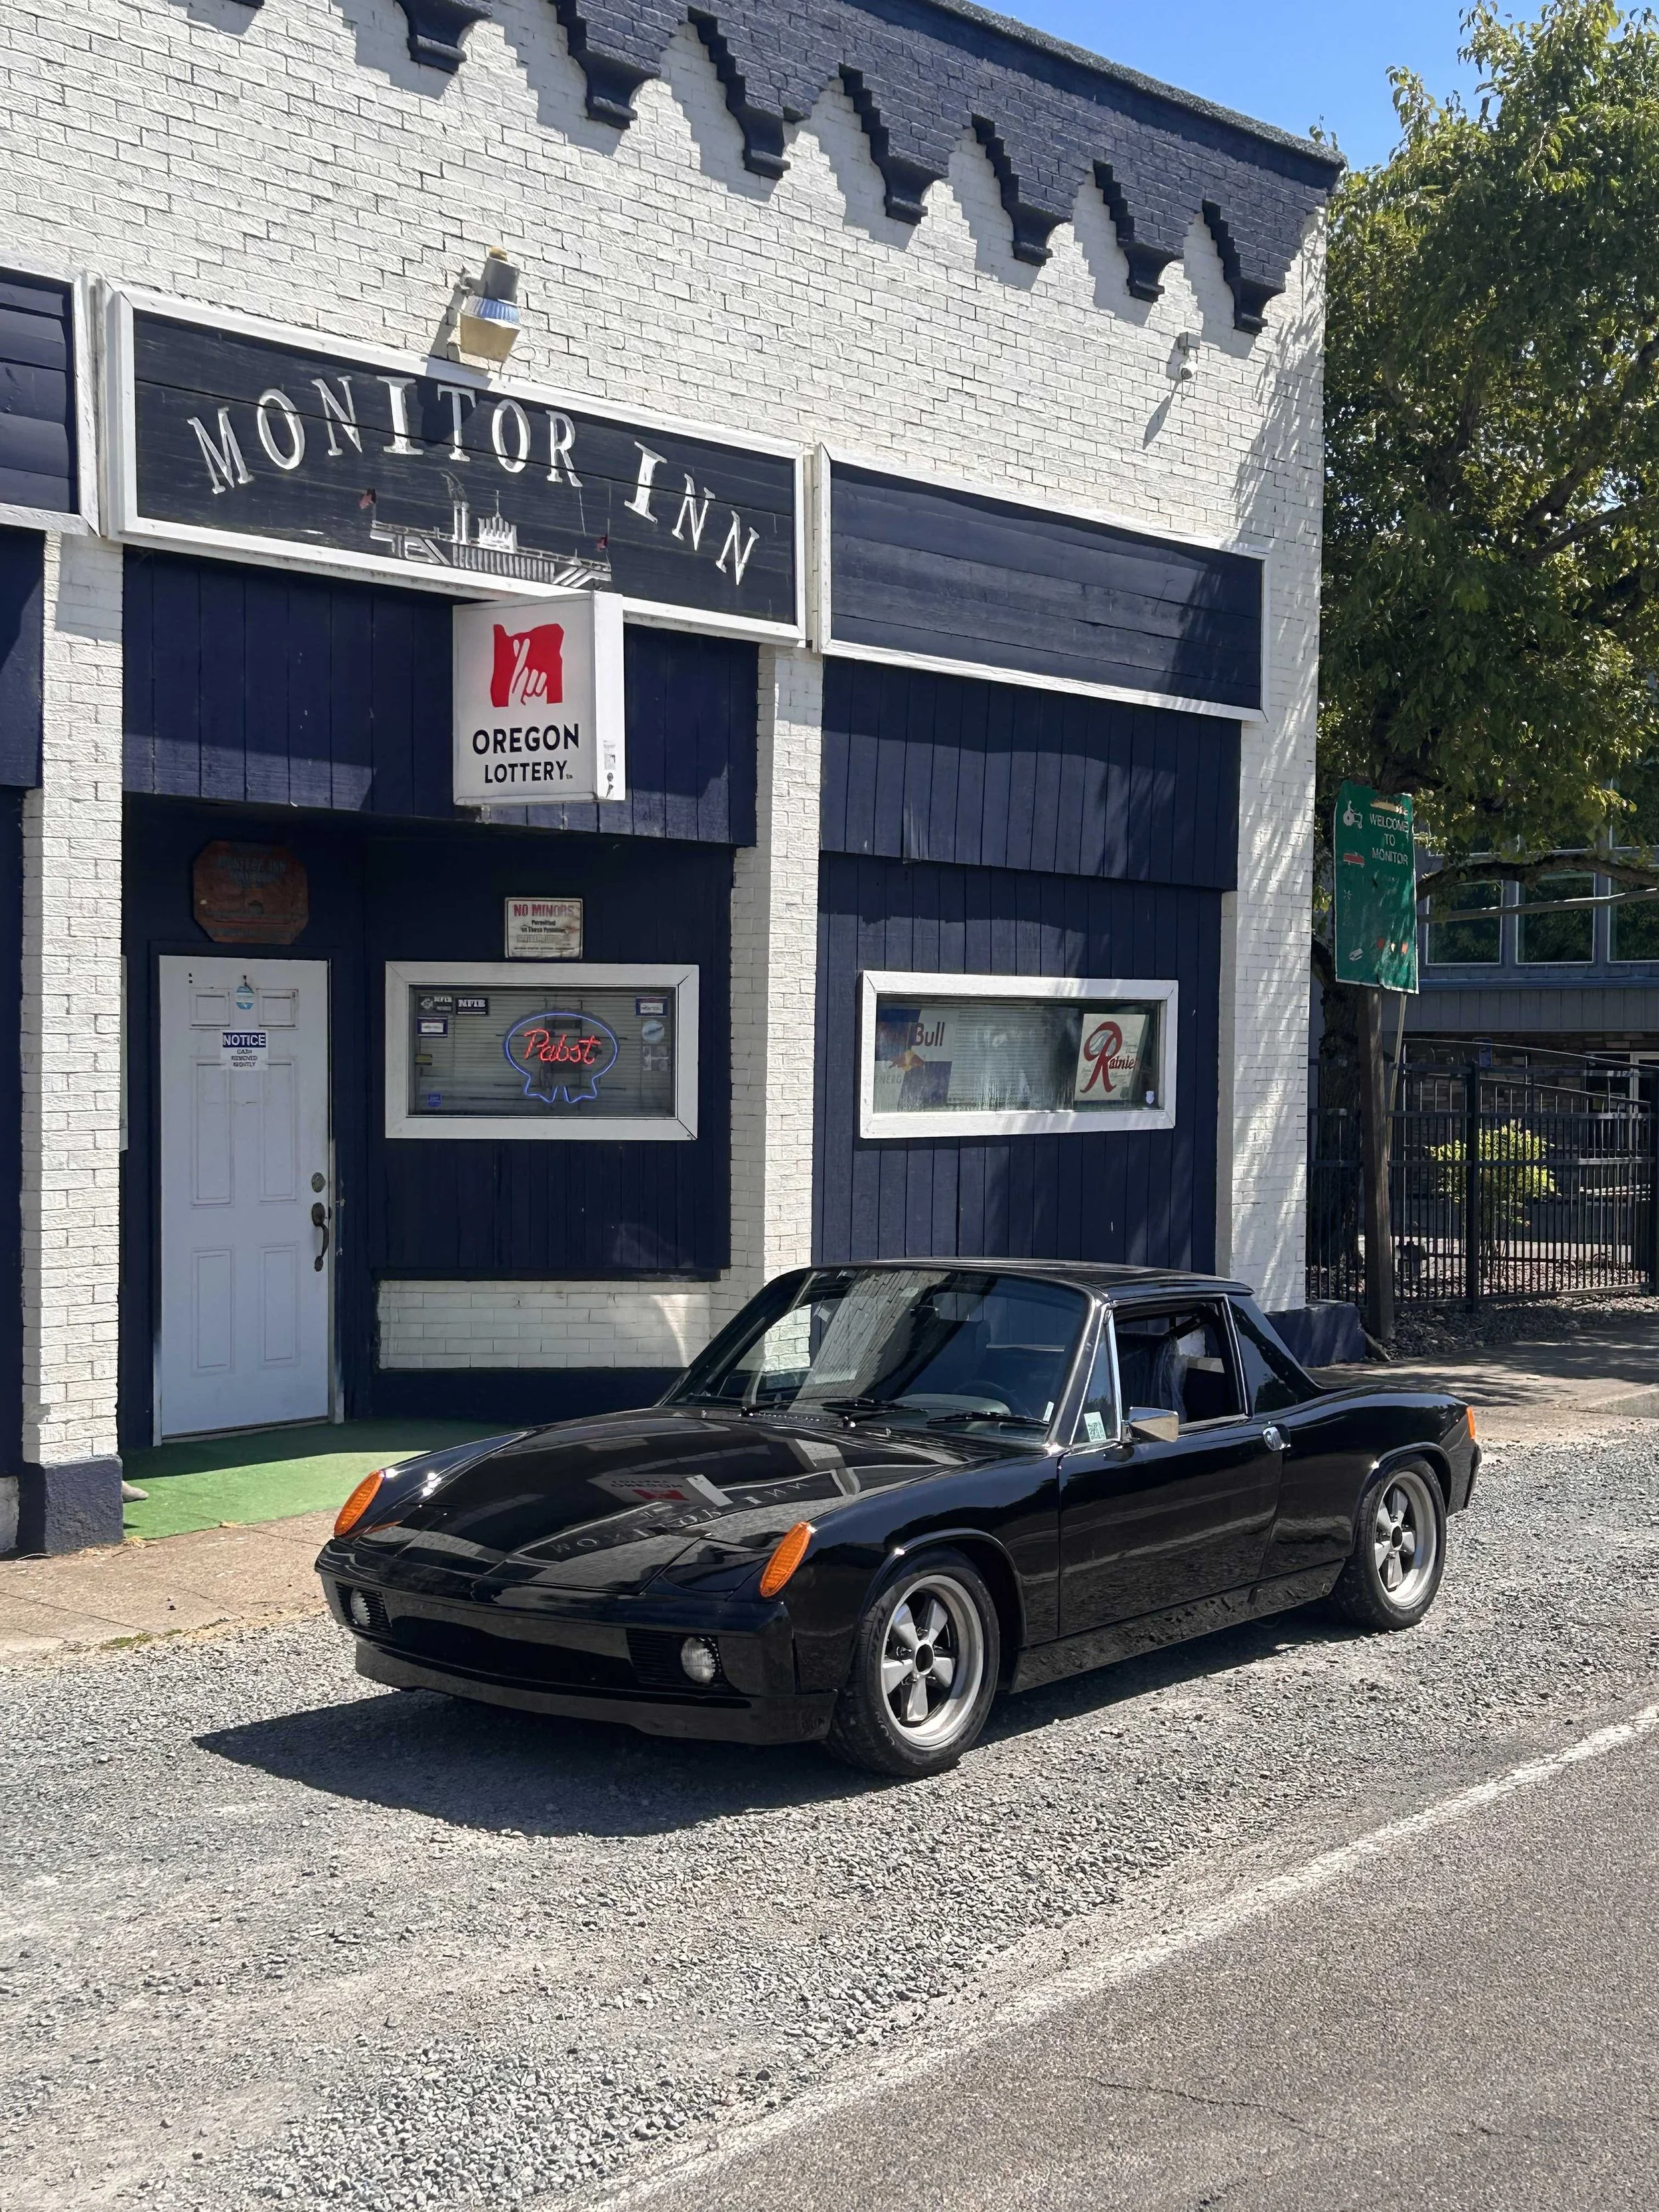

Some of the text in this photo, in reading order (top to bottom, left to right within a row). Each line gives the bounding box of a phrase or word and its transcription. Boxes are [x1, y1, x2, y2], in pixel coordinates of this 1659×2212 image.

[186, 374, 760, 586] MONITOR INN
[472, 723, 579, 755] OREGON
[484, 761, 567, 783] LOTTERY
[1370, 813, 1409, 832] WELCOME
[1384, 834, 1395, 846] TO
[1372, 847, 1408, 866] MONITOR
[514, 904, 573, 917] NO MINORS
[224, 1034, 265, 1046] NOTICE
[911, 1021, 946, 1047] Bull
[523, 1027, 601, 1065] Pabst
[1080, 1021, 1137, 1093] Rainie
[875, 1074, 902, 1084] ENERG
